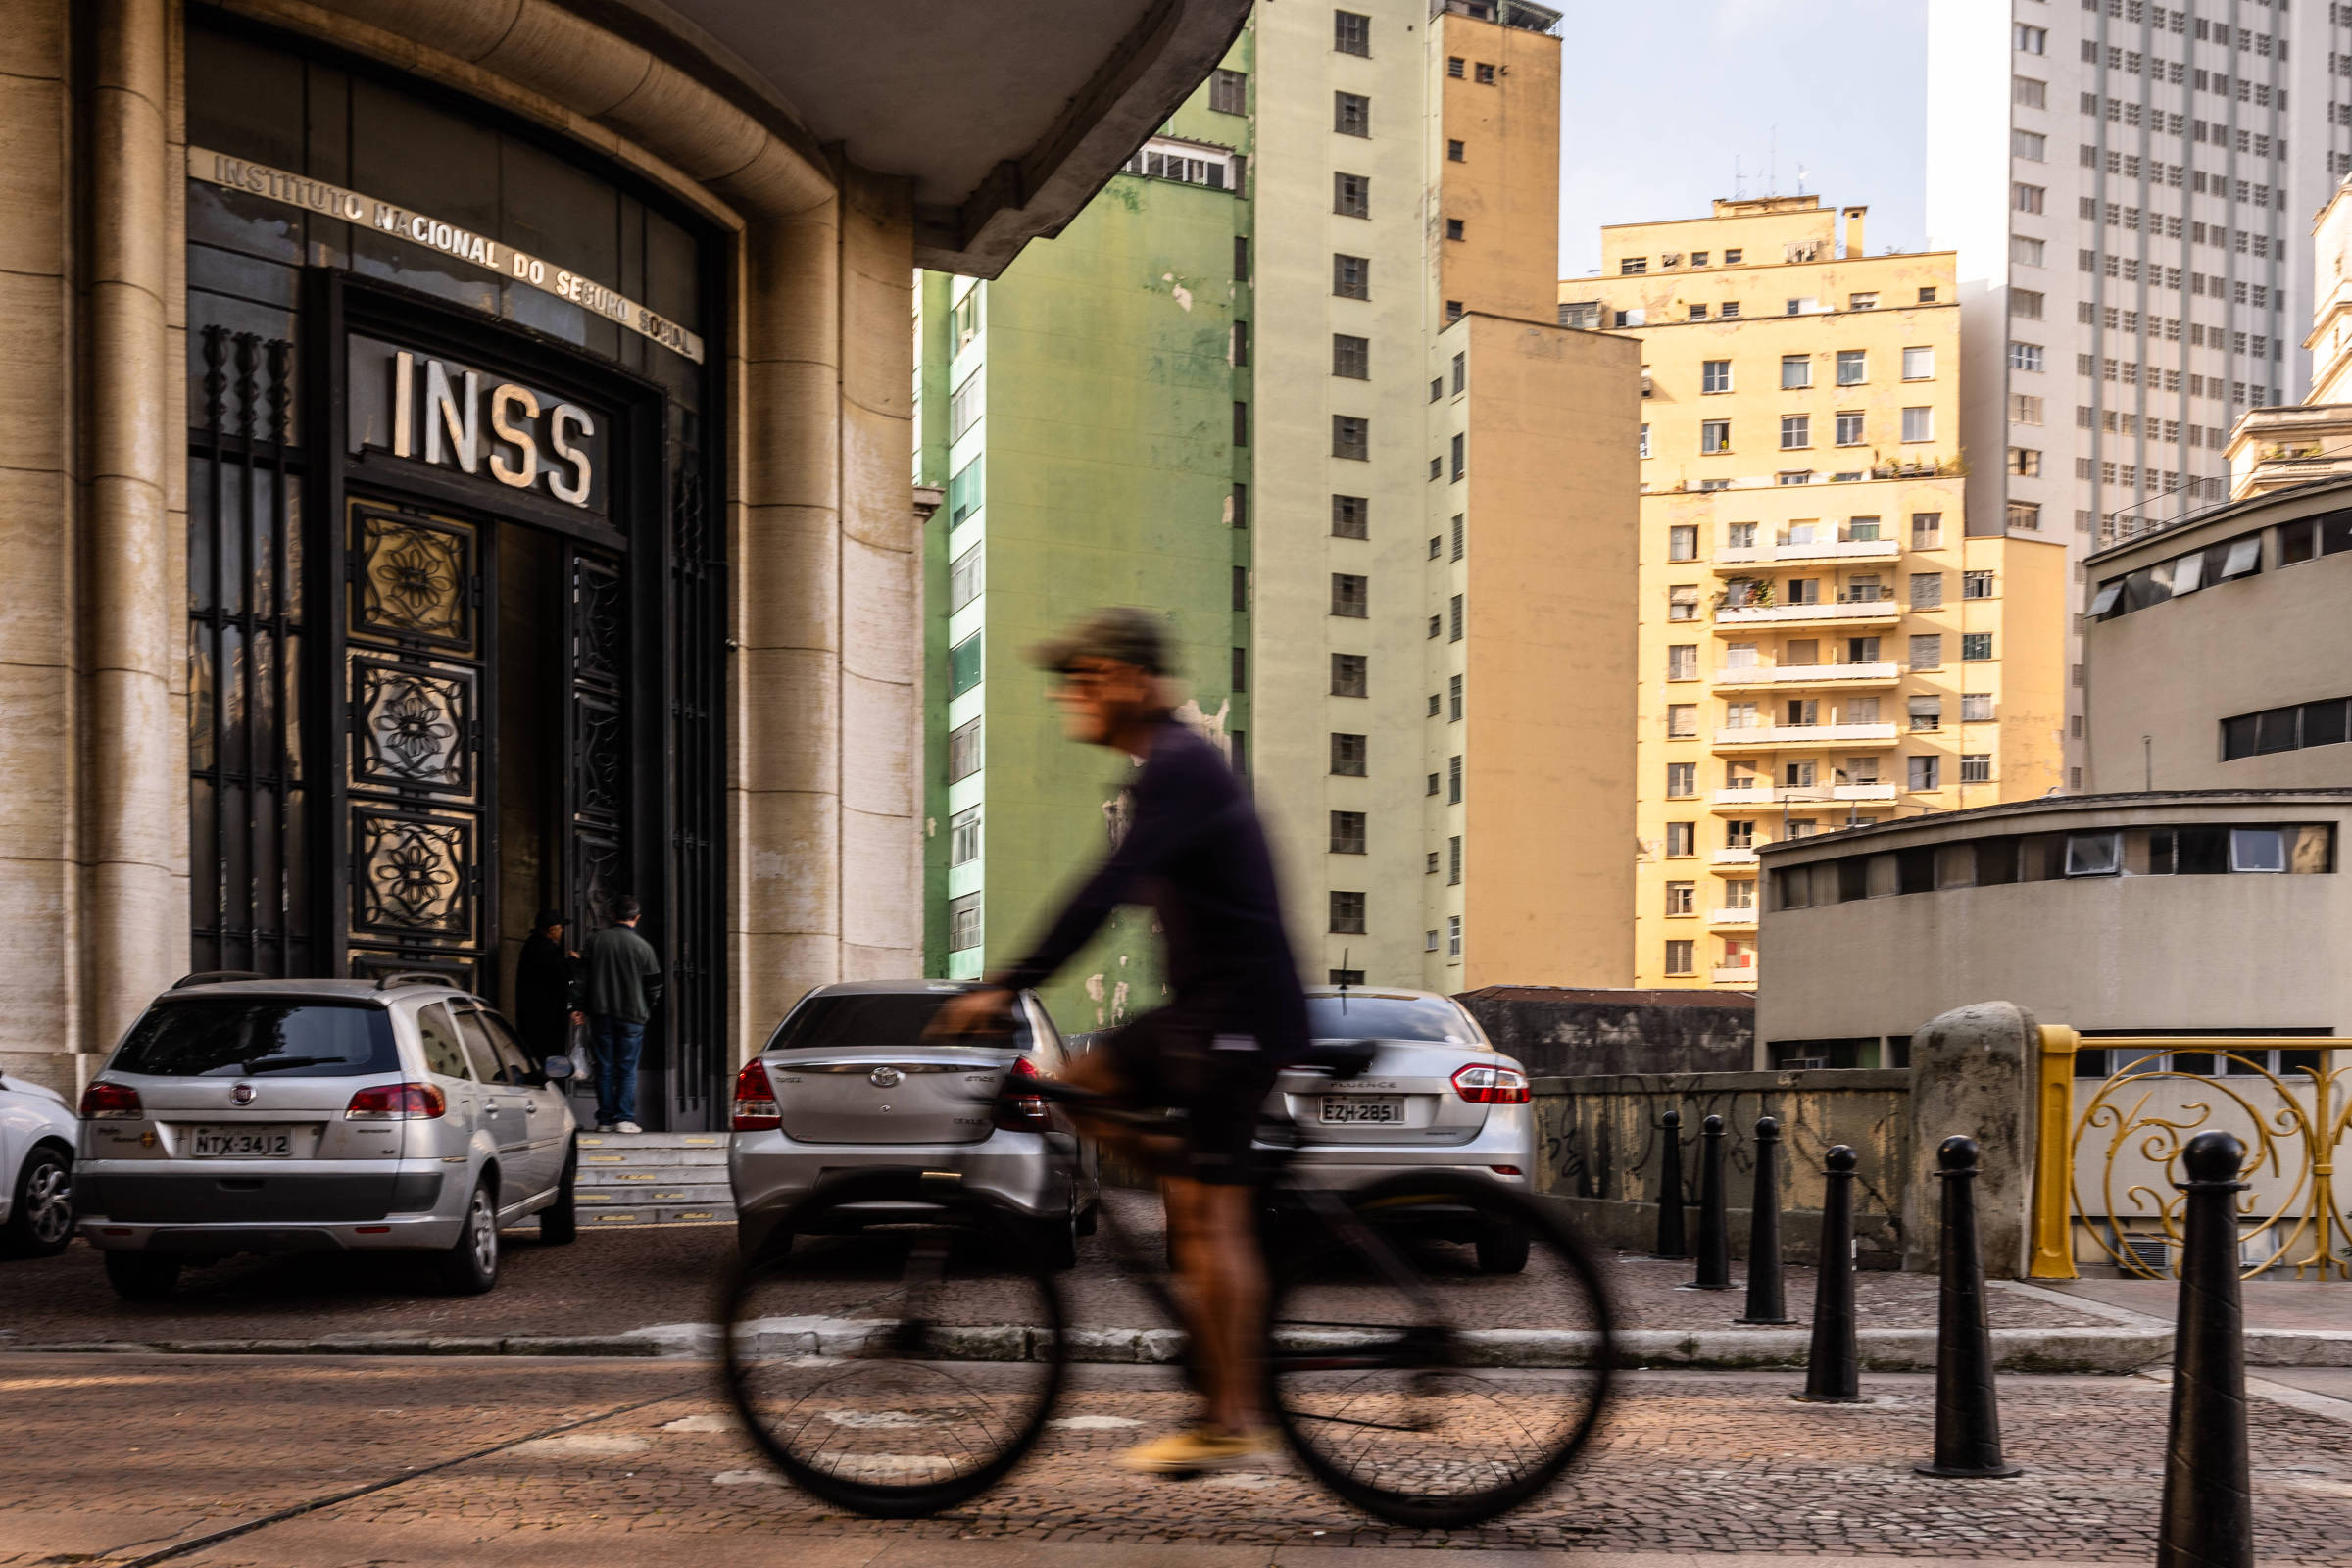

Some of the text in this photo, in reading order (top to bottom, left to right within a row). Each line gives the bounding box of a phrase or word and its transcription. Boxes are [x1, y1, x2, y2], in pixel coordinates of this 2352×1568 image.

[214, 155, 693, 355] INSTITUTO NACIONAL DO SEGURO SOCIAL
[394, 351, 595, 508] INSS
[196, 1136, 288, 1153] NTX-3412
[1324, 1104, 1399, 1121] EZH-2851
